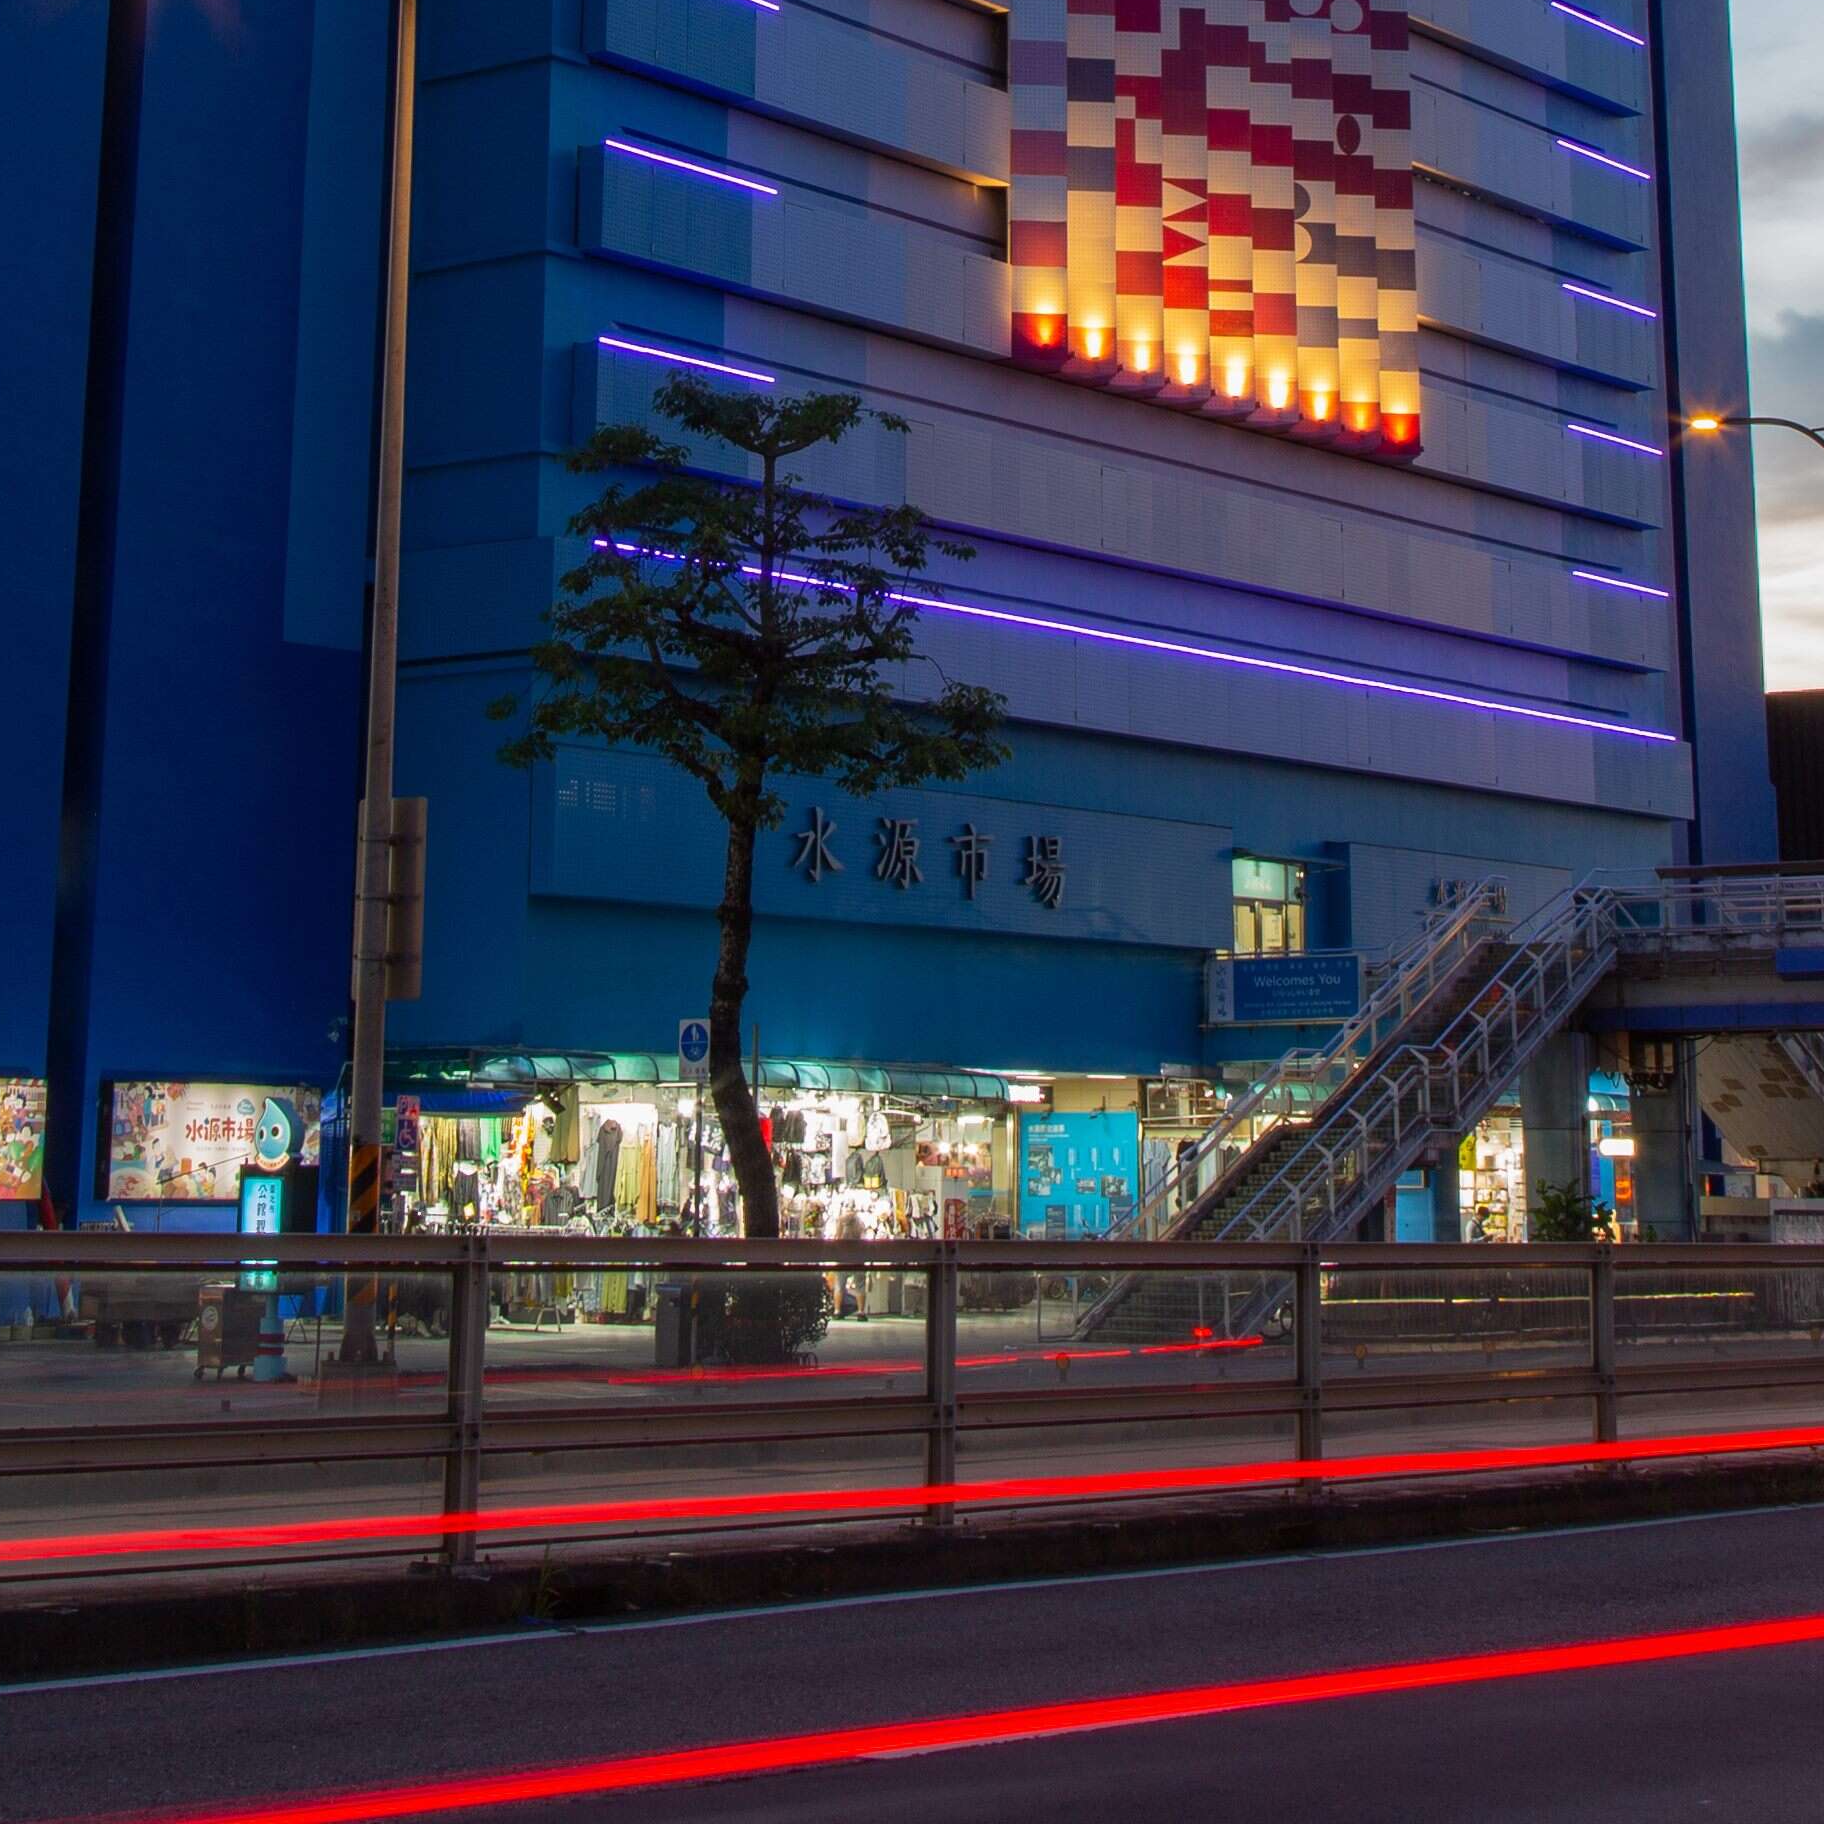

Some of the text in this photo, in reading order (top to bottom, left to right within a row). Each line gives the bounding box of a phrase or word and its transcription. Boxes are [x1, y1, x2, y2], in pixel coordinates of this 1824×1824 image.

[792, 806, 1067, 909] 水源市場
[1254, 972, 1342, 988] Welcomes You
[185, 1117, 255, 1143] 水源市場
